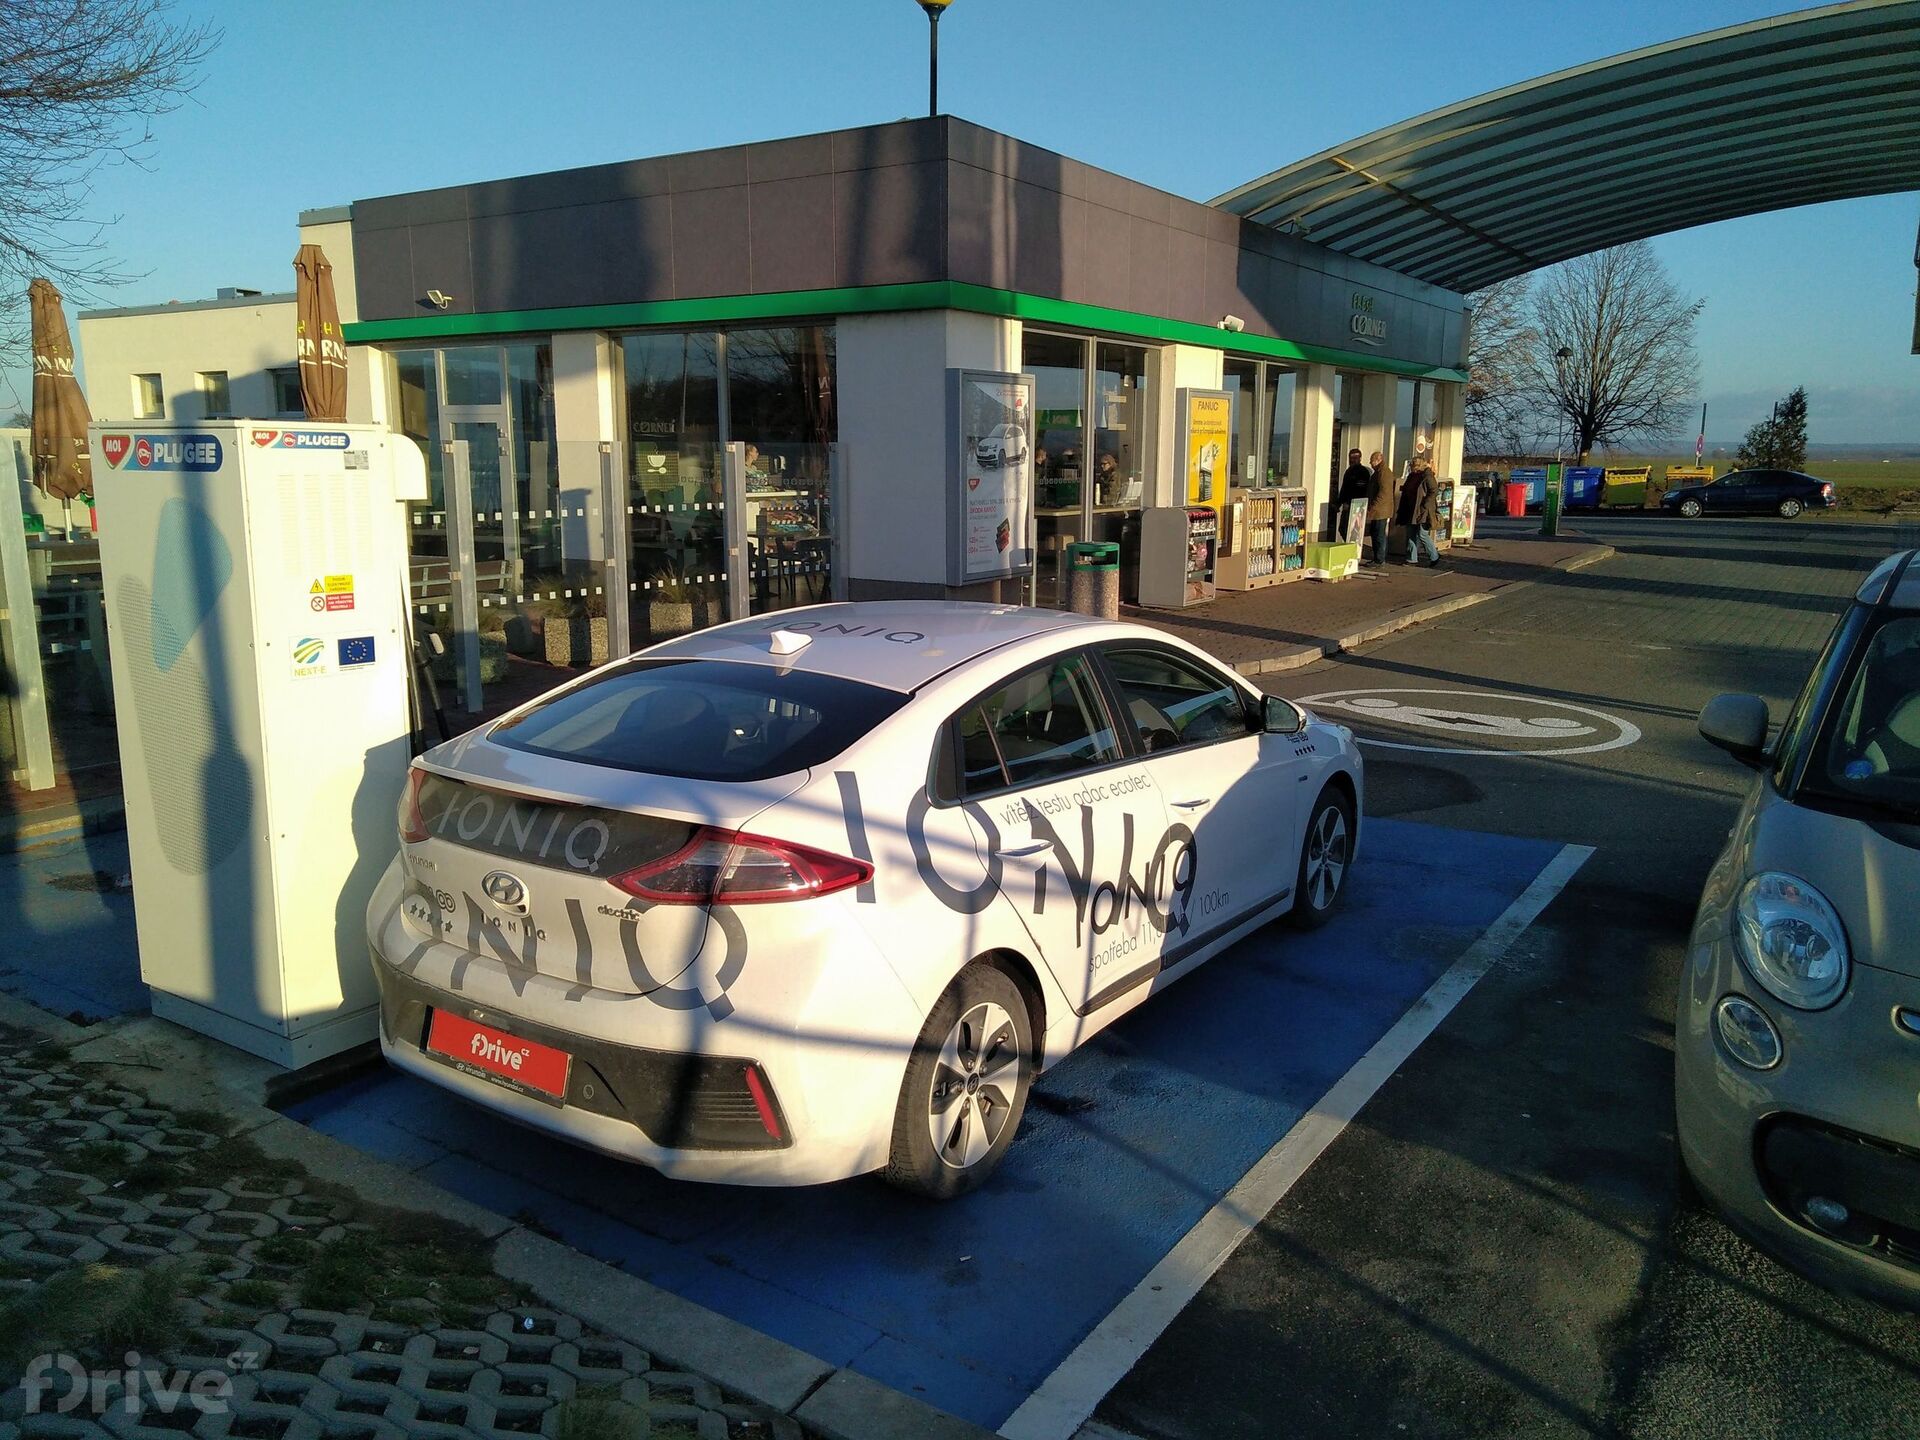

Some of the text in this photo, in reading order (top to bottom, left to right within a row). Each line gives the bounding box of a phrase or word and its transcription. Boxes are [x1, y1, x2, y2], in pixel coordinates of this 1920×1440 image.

[1197, 401, 1219, 411] FANUC
[255, 432, 346, 446] MOL PLUGEE
[105, 440, 216, 463] MOL PLUGEE
[762, 621, 925, 644] IONIQ
[294, 665, 327, 677] NEXT-E
[1000, 773, 1151, 826] vítěz testu adac ecotec
[437, 789, 610, 873] IONIQ
[598, 905, 641, 921] electric
[481, 913, 547, 941] IONIQ
[1089, 931, 1138, 977] spotřeba
[1199, 888, 1230, 917] 100km
[471, 1033, 522, 1070] fDrive
